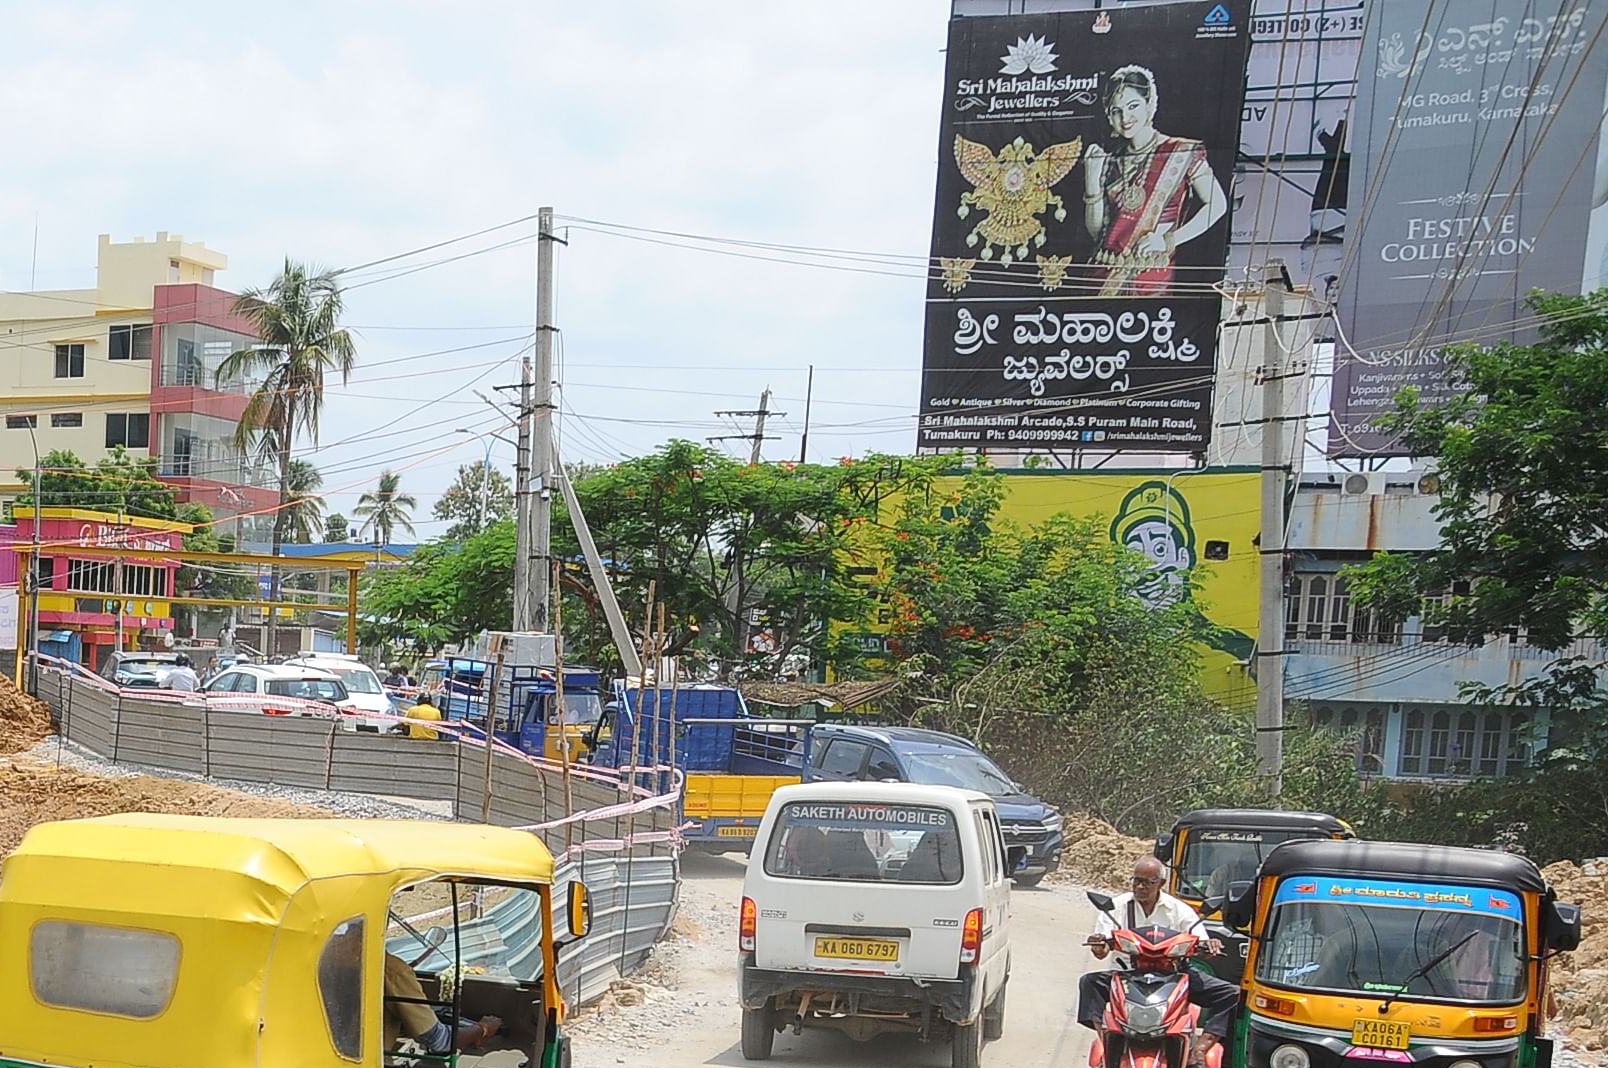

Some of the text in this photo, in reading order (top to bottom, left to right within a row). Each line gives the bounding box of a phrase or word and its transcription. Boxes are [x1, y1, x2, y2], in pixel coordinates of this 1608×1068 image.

[957, 73, 1098, 95] Sri Mahalakshmi
[988, 94, 1060, 112] Jewellers
[1406, 215, 1516, 240] FESTIVE
[1381, 237, 1535, 263] COLLECTION
[954, 307, 1000, 354] ಶ್ರೀ
[930, 398, 949, 406] Gold
[960, 398, 992, 408] Antique
[1002, 398, 1025, 406] Silver
[1033, 398, 1071, 406] Diamond
[1127, 399, 1168, 409] Corporate
[1170, 399, 1200, 410] Gifting
[924, 416, 940, 426] Sri
[944, 415, 1018, 426] Mahalakshmi
[1088, 416, 1126, 427] Puram
[1130, 417, 1158, 427] Main
[1162, 417, 1197, 430] Road,
[923, 429, 980, 440] Tumakuru
[986, 429, 1005, 440] Ph:
[791, 806, 947, 826] SAKETH AUTOMOBILES
[823, 941, 896, 957] KA 06D 6797
[1364, 1022, 1402, 1035] KA06A
[1362, 1034, 1401, 1047] C0161
